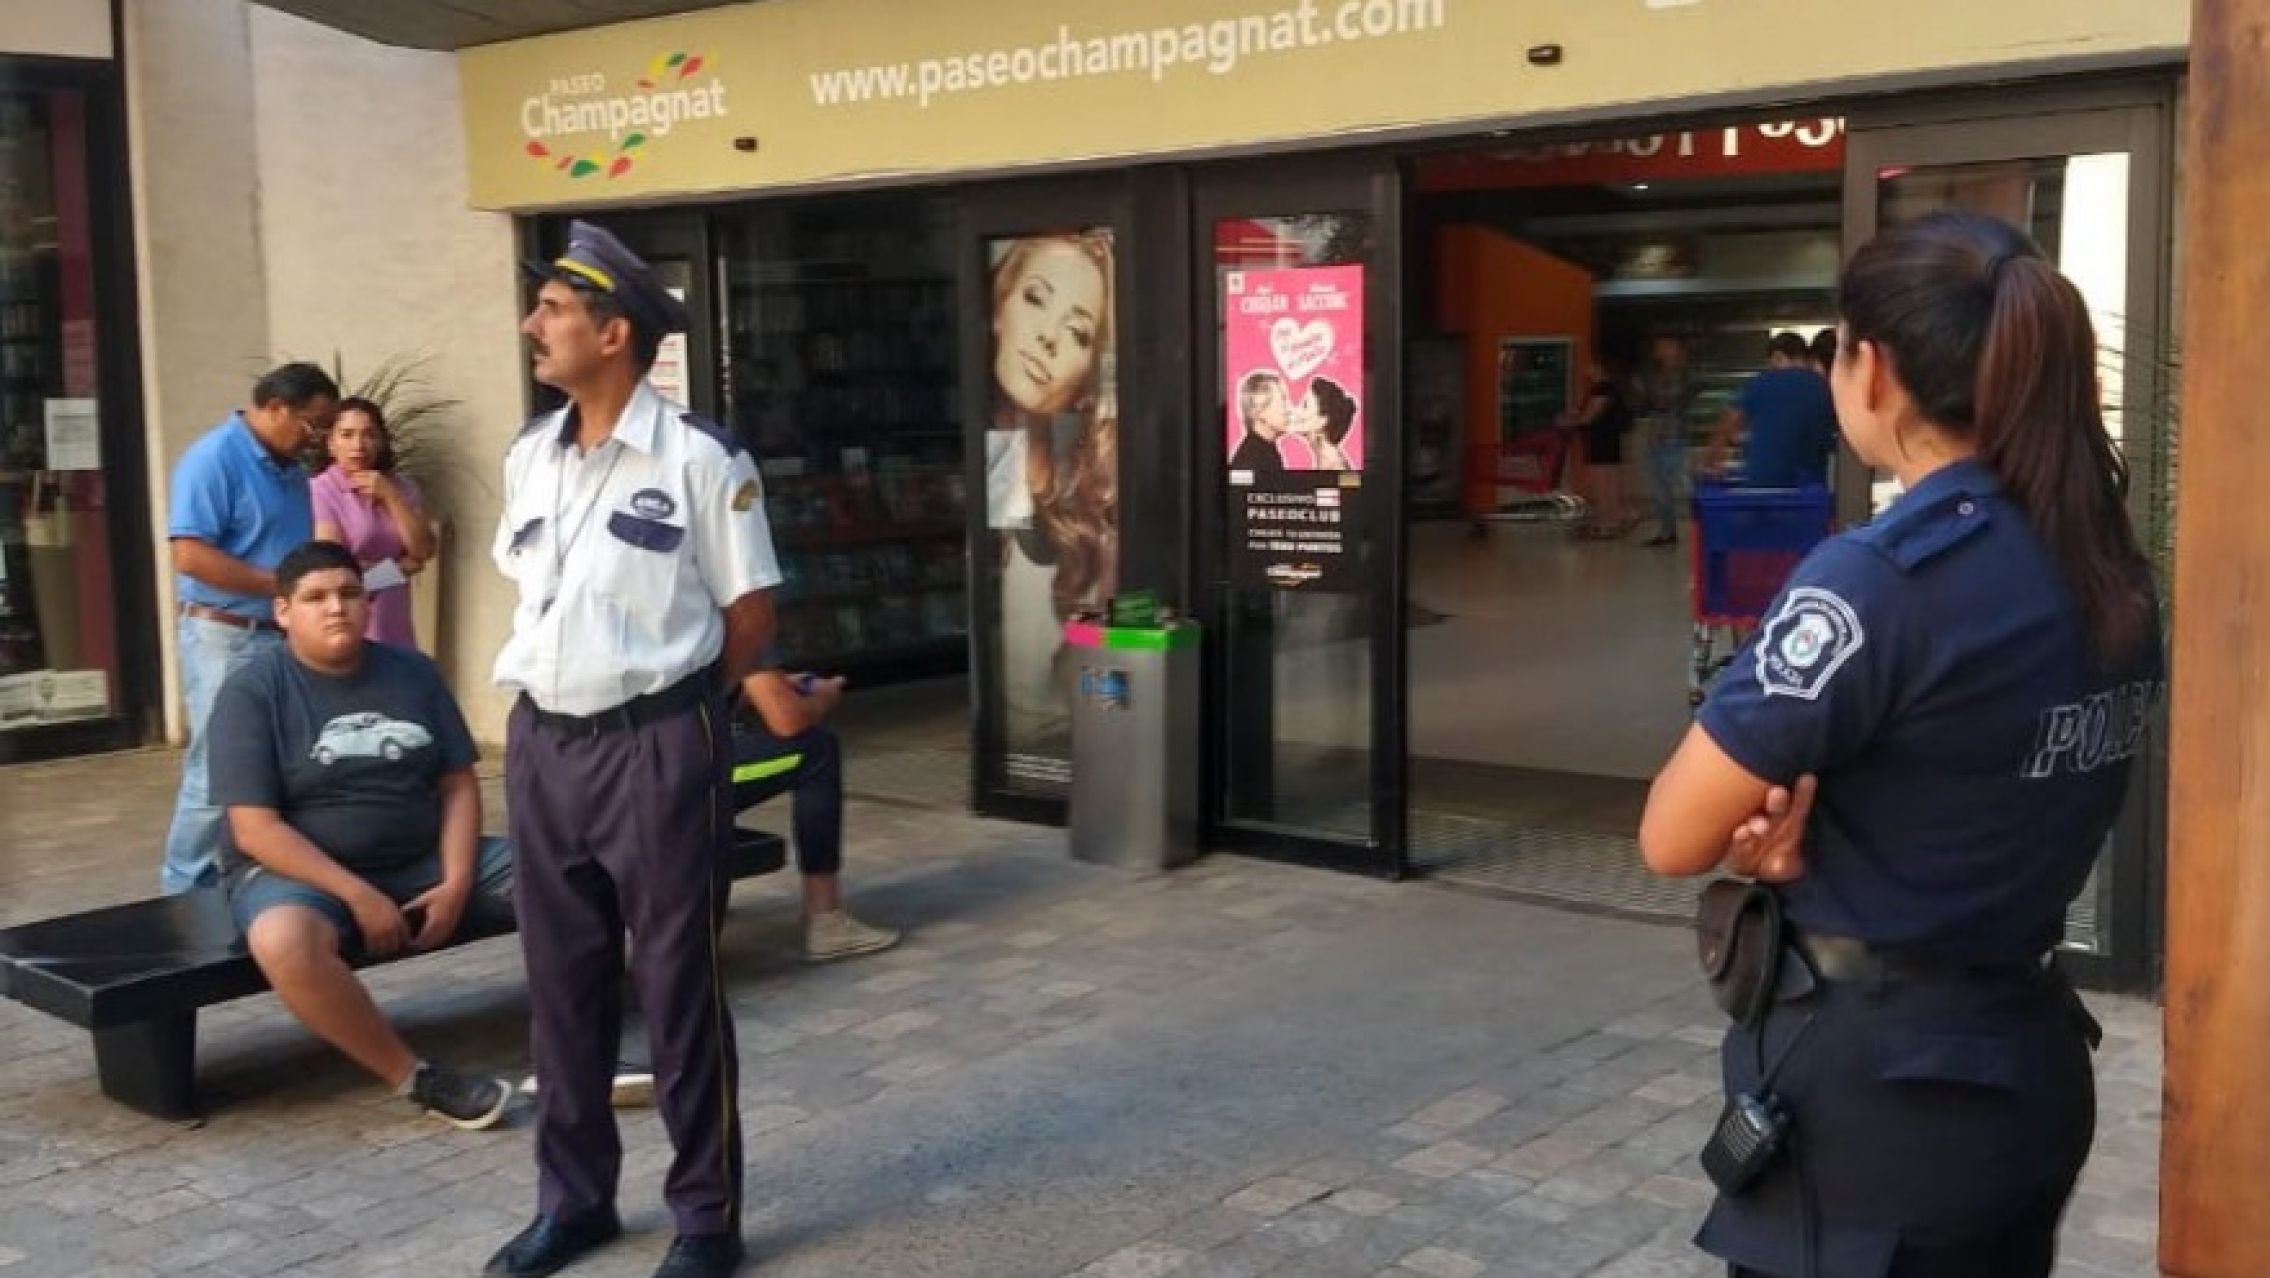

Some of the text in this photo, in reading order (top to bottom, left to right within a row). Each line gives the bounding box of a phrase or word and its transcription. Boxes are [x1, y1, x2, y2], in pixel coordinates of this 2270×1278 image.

[550, 74, 605, 94] PASEO
[810, 0, 1446, 107] www.paseochampagnat.com
[521, 78, 728, 141] Champagnat
